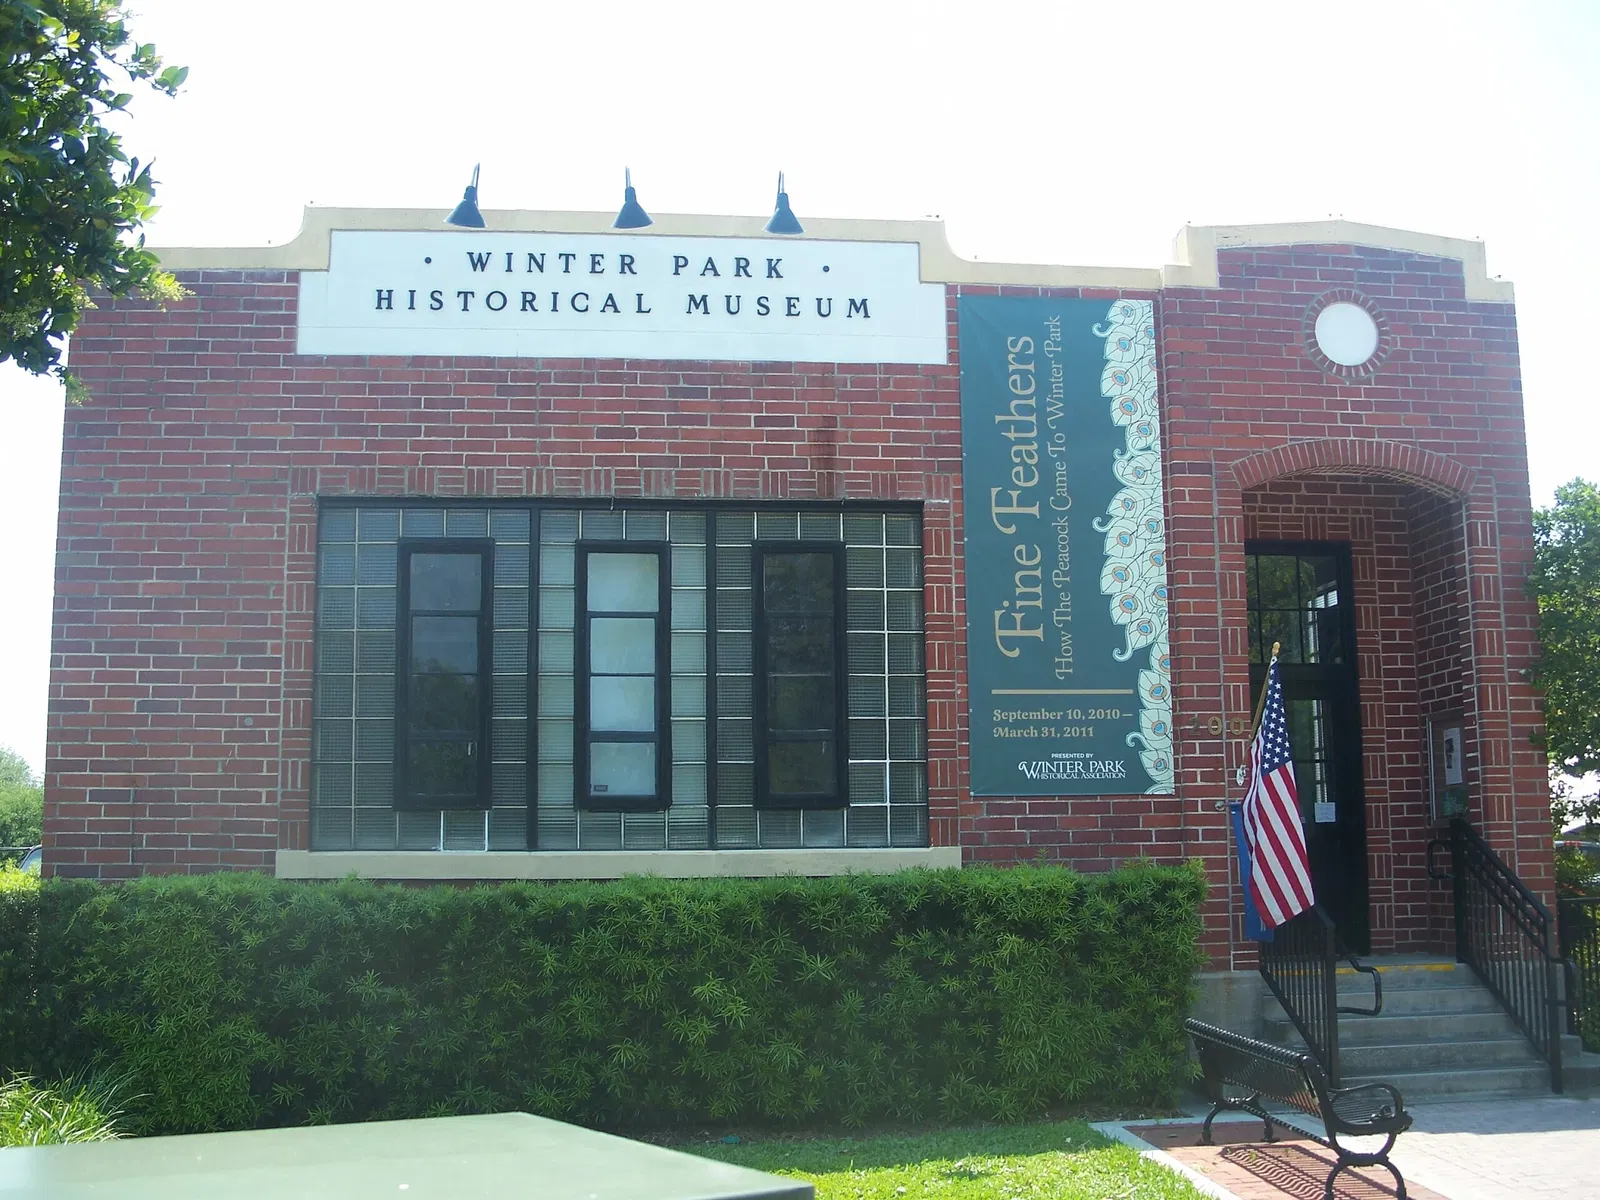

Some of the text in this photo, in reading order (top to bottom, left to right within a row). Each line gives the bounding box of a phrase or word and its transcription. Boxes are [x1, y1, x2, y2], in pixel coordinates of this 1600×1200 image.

[467, 251, 785, 279] WINTER PARK
[375, 288, 872, 319] HISTORICAL MUSEUM
[990, 336, 1045, 658] Fine Feathers
[1043, 314, 1074, 680] How The Peacock Came To Winter Park
[993, 708, 1063, 722] September
[1066, 708, 1086, 721] 10,
[993, 725, 1094, 738] March 31, 2011
[1018, 760, 1127, 780] WINTER PARK
[1037, 771, 1126, 780] HISTORICAL ASSOCIATION
